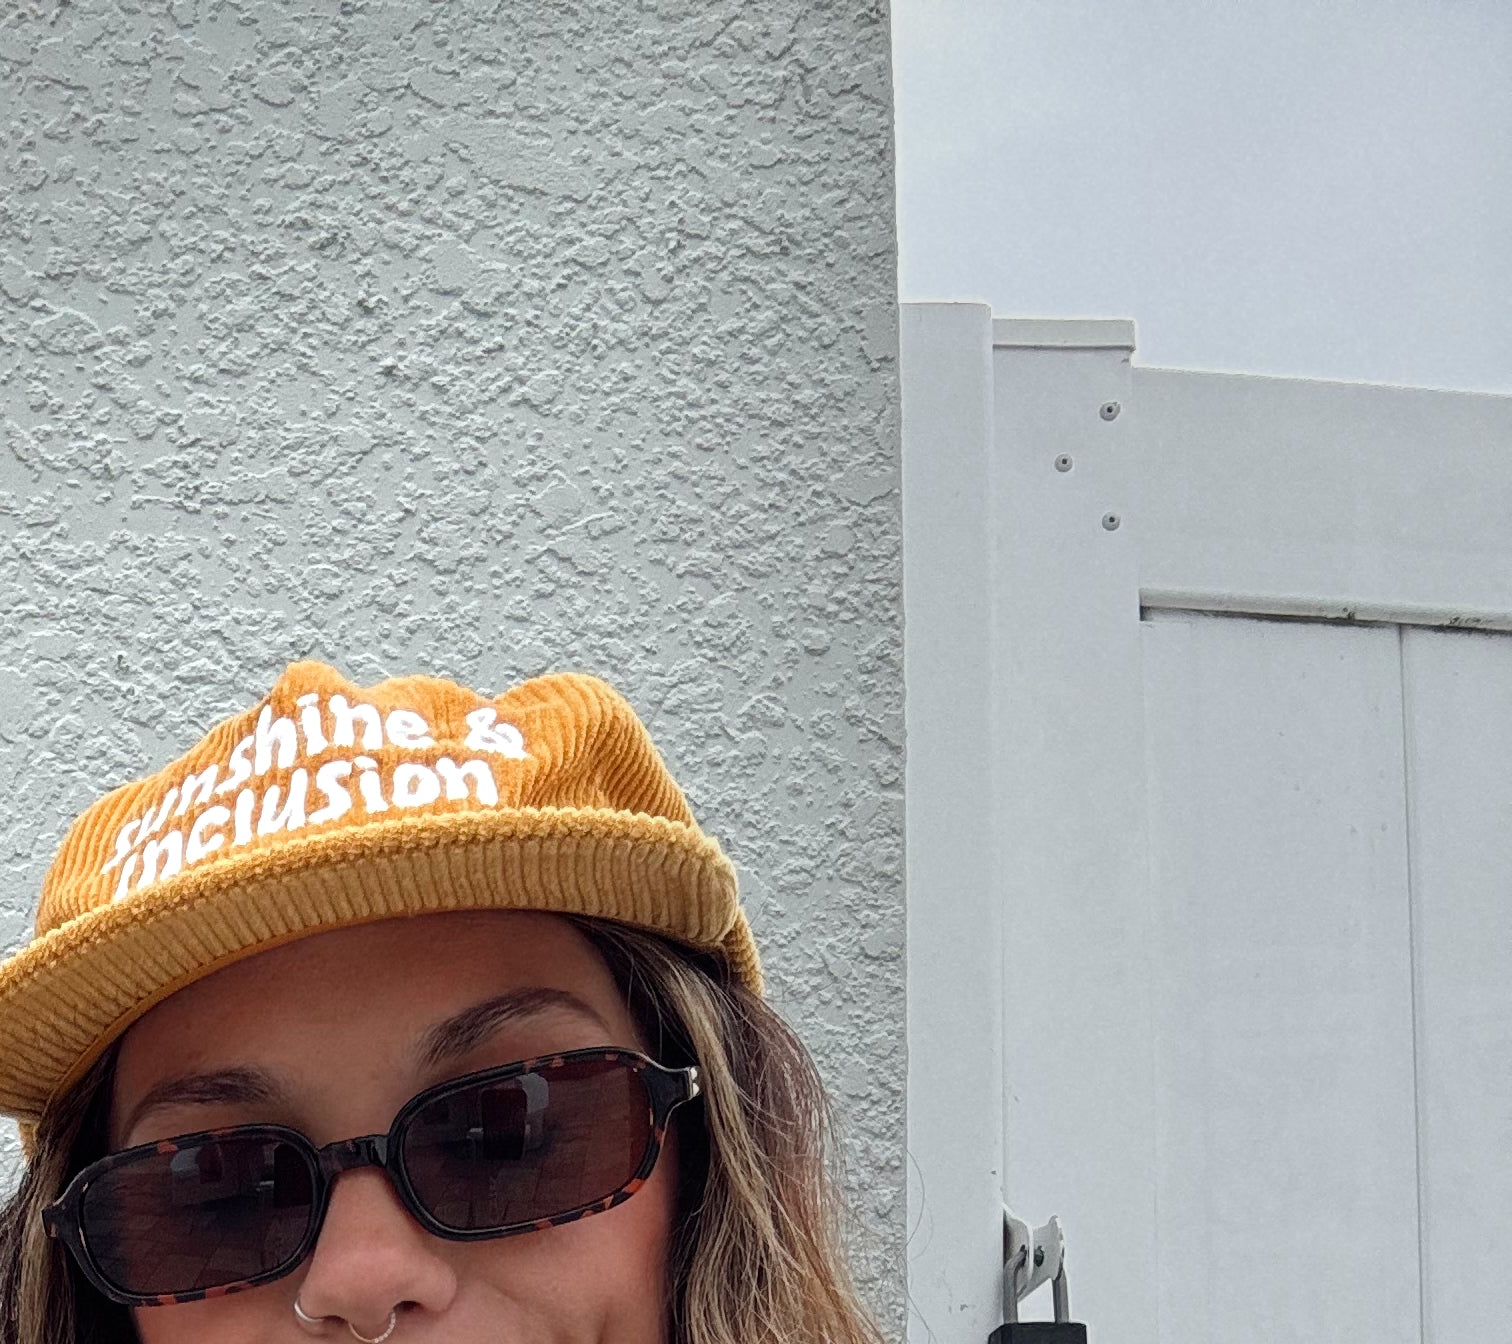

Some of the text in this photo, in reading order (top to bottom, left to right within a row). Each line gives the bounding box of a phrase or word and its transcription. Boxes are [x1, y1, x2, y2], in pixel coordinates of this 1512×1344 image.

[100, 693, 528, 876] sunshine &
[114, 756, 500, 901] inclusion
